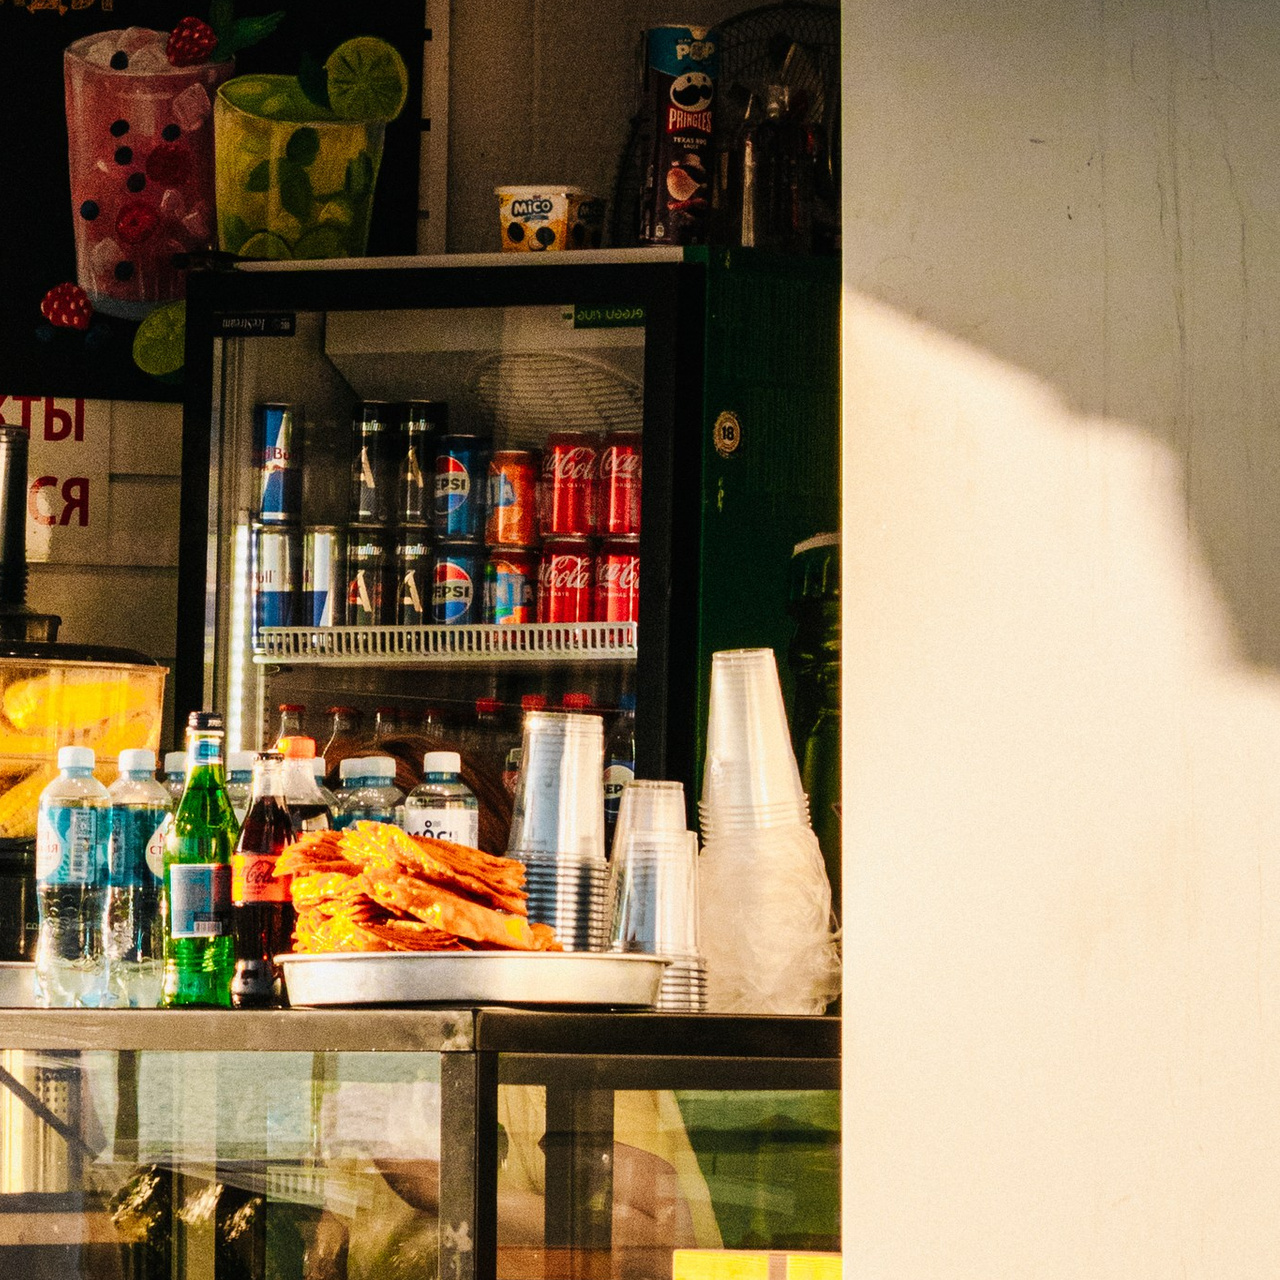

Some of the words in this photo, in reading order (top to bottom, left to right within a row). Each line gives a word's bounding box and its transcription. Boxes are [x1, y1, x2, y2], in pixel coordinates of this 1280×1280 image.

[669, 107, 713, 133] PRINGLES
[722, 425, 734, 441] 18
[434, 477, 466, 491] EPSI
[433, 585, 470, 598] EPSI
